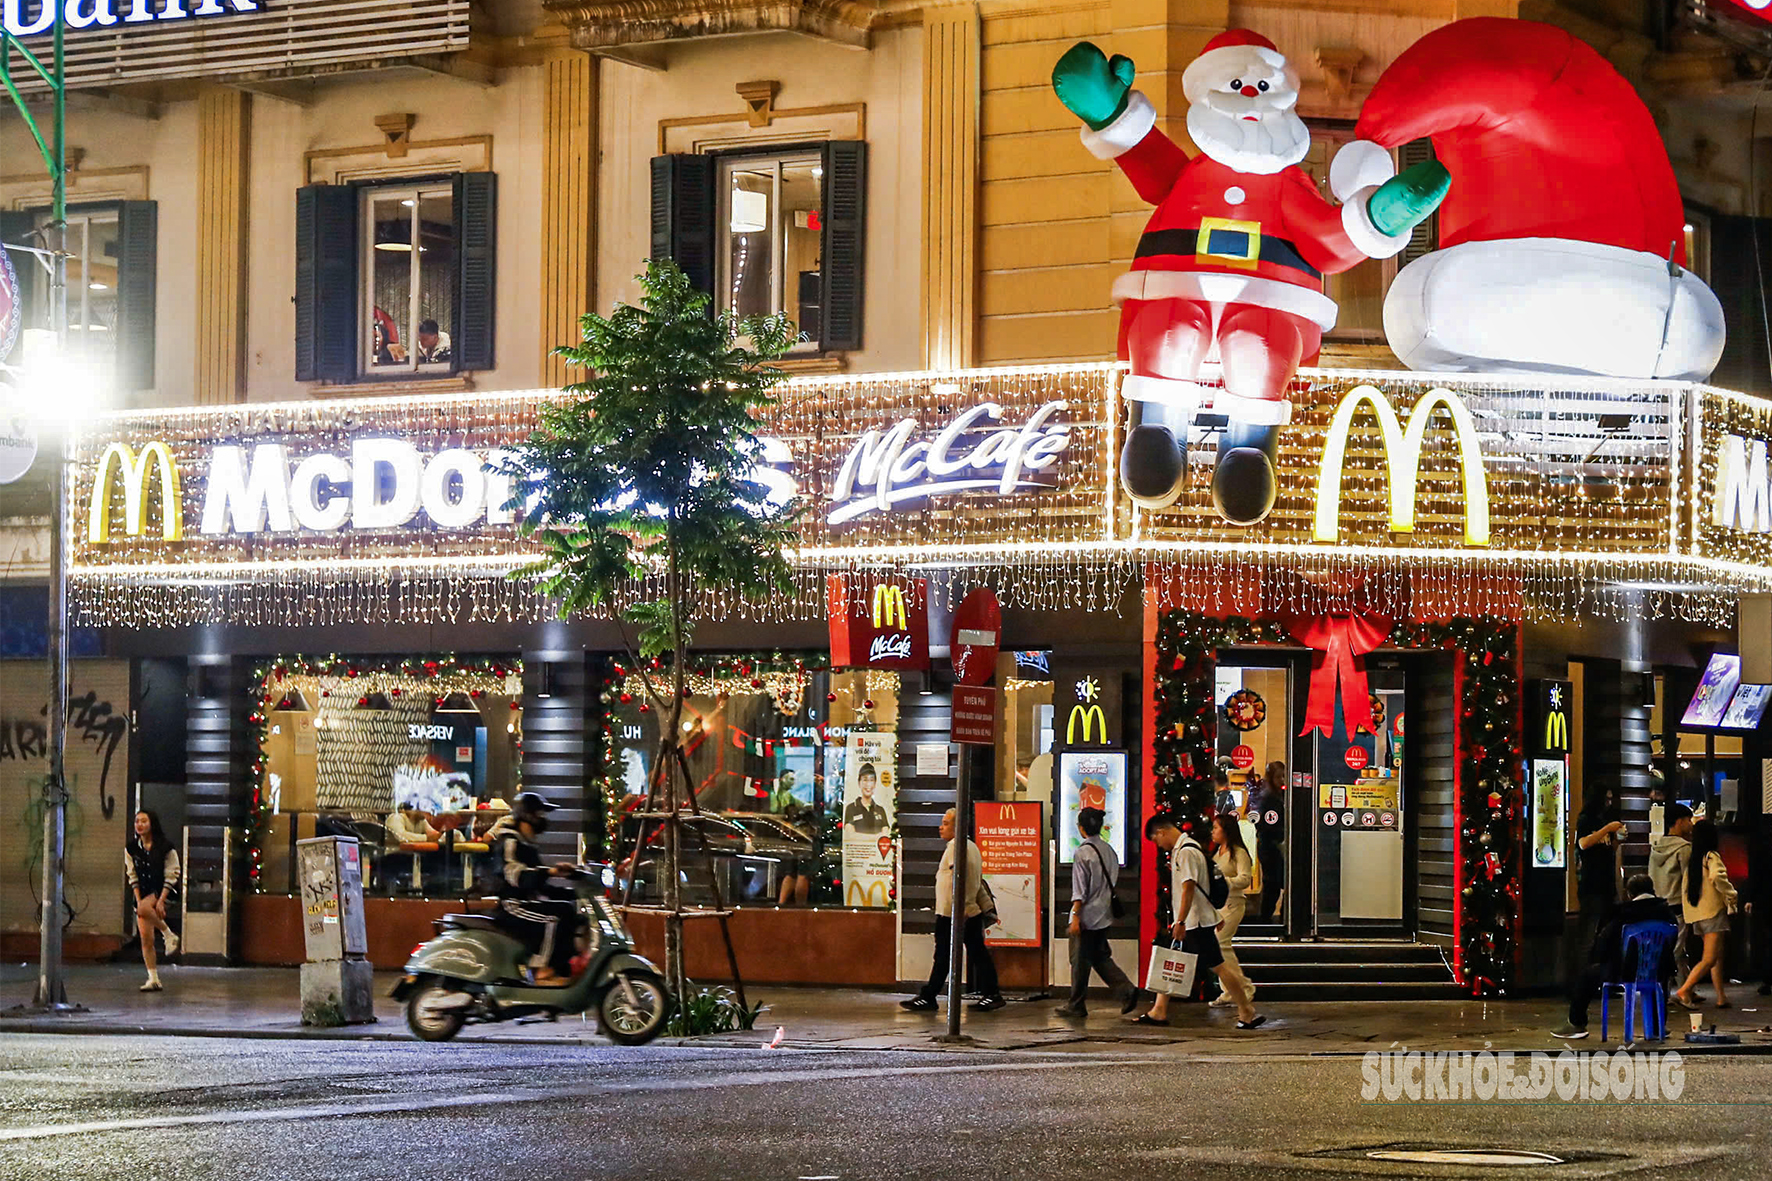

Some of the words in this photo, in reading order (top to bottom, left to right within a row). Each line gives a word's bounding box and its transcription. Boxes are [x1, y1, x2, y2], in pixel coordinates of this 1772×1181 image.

[827, 400, 1070, 524] McCafé
[1713, 433, 1772, 534] M
[869, 634, 911, 661] McCafé
